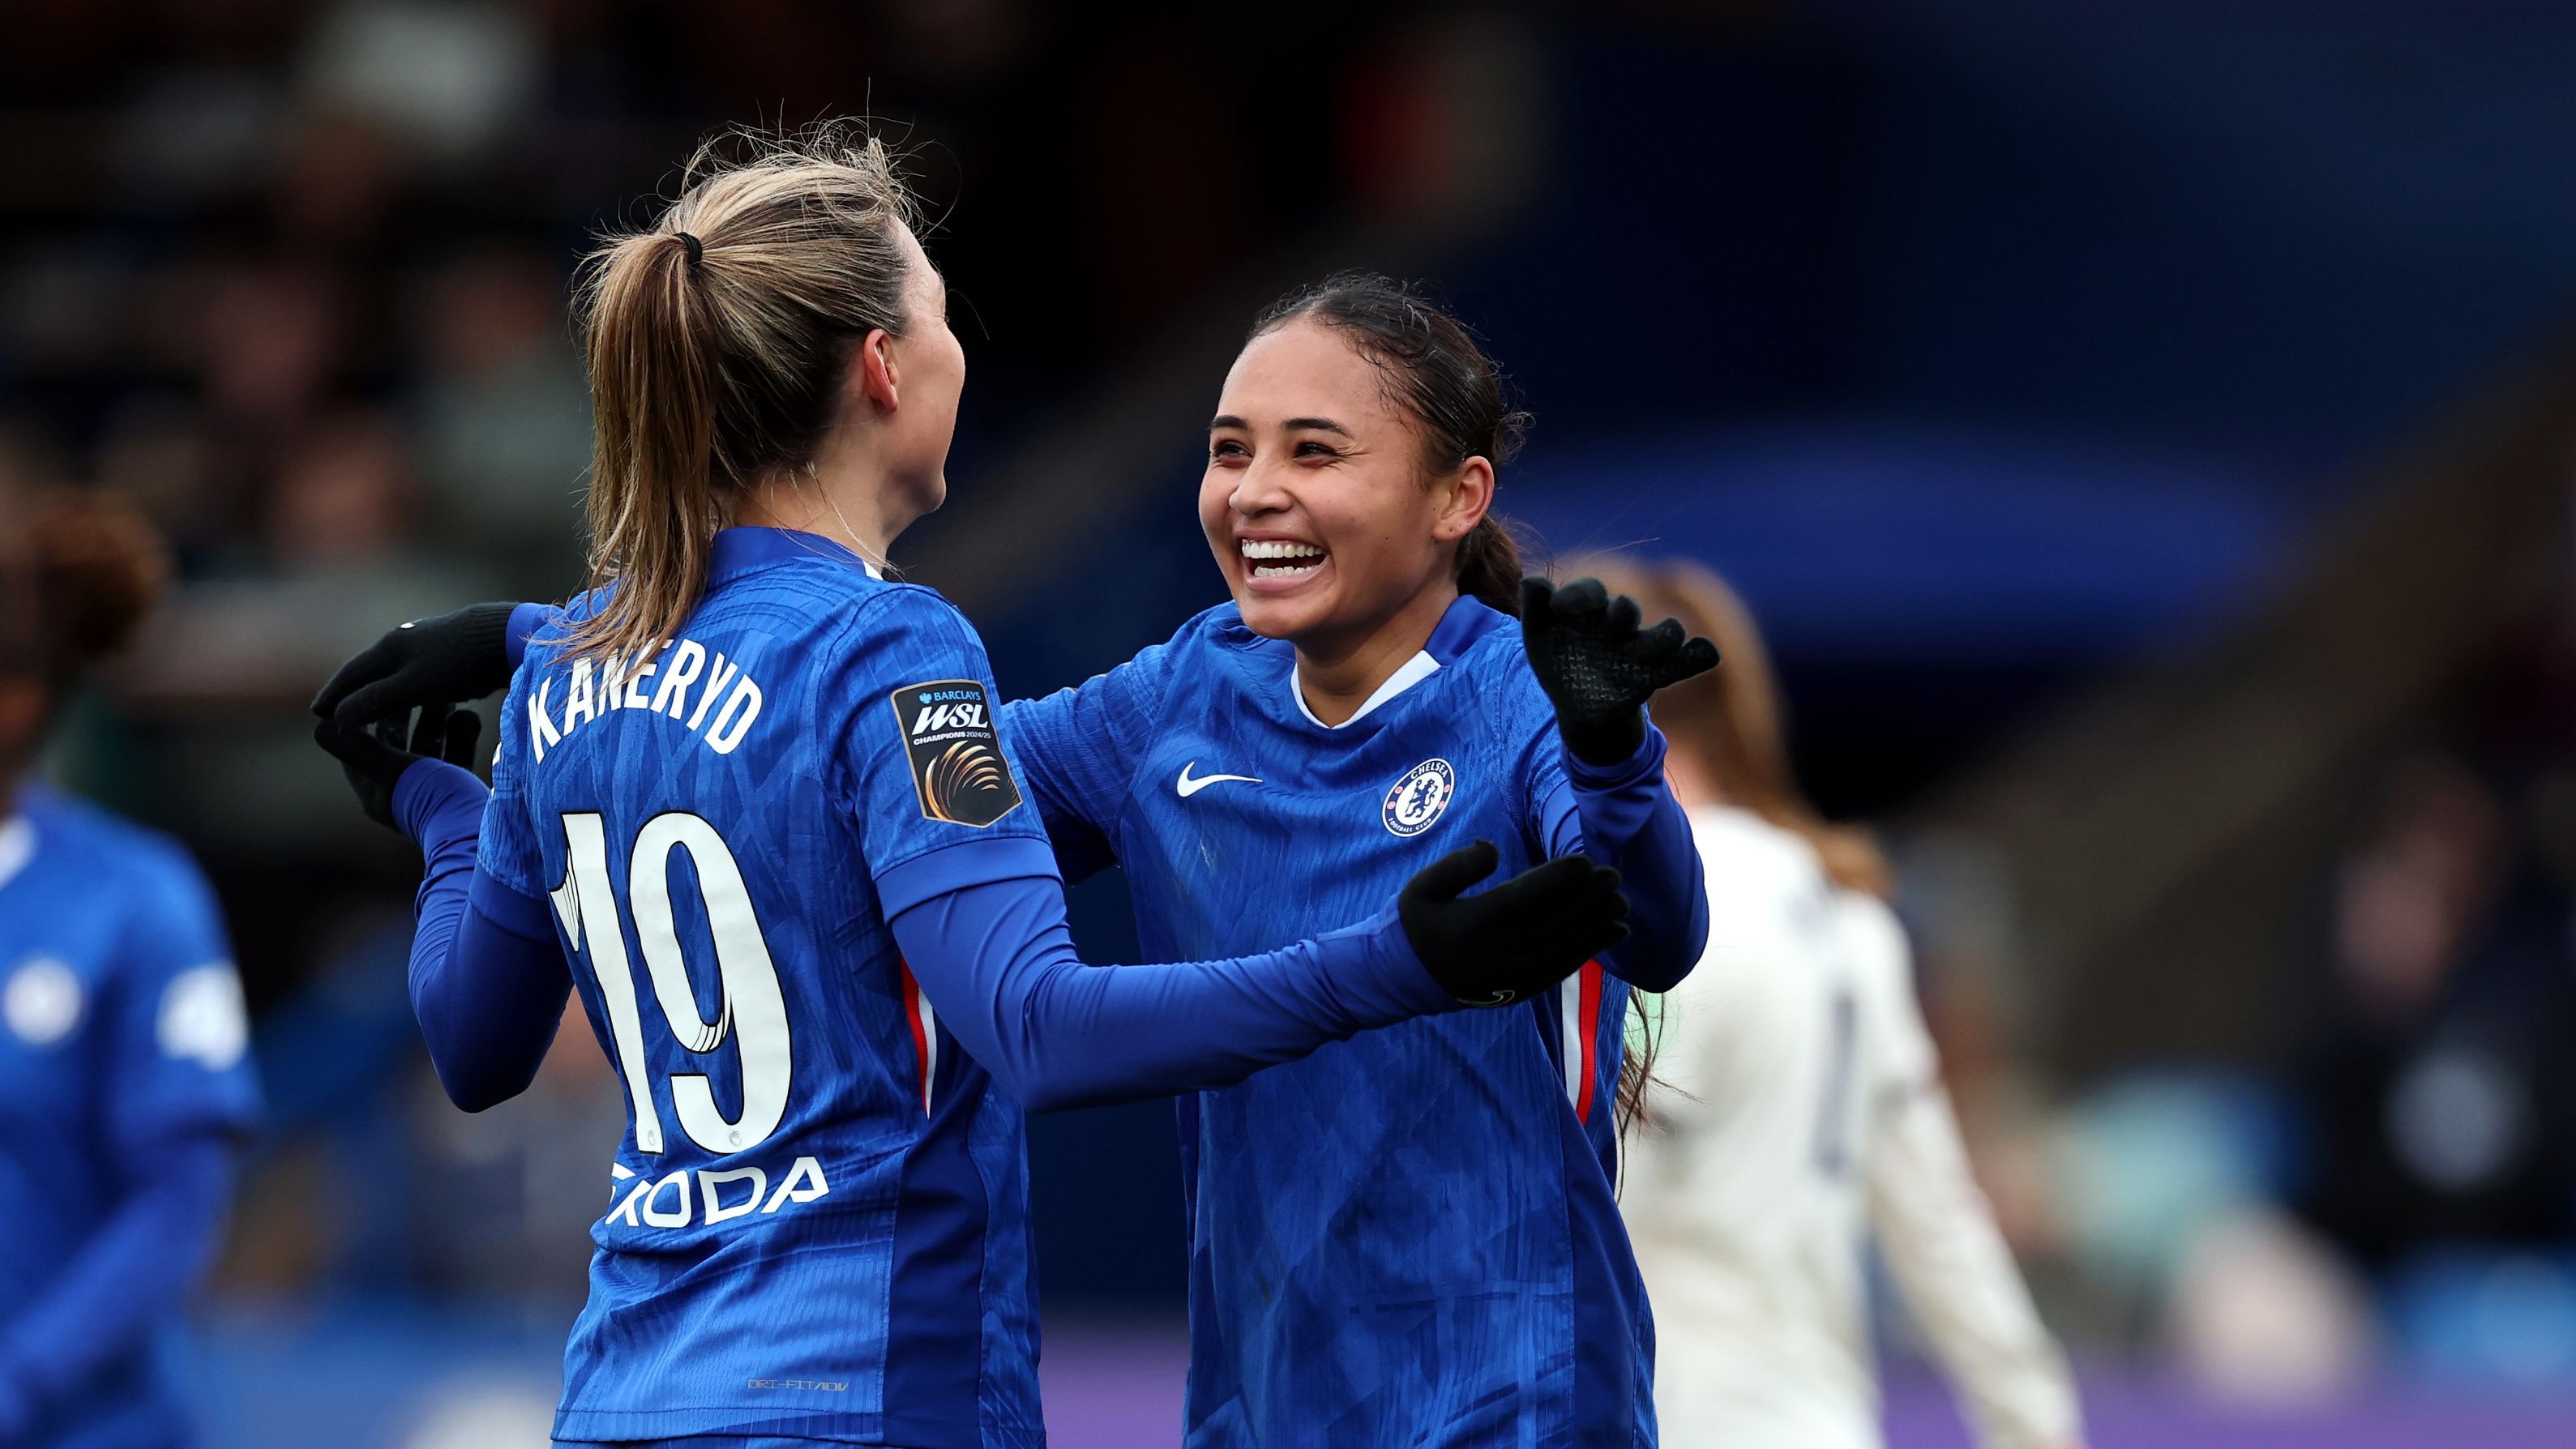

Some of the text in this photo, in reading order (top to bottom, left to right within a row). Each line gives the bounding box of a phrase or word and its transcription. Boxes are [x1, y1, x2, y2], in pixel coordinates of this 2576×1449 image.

[528, 639, 763, 765] KANERYD
[934, 690, 981, 702] BARCLAYS
[911, 703, 988, 736] WSL
[914, 731, 991, 746] CHAMPIONS 2024/25
[1410, 762, 1448, 780] CHELSEA
[1388, 818, 1431, 832] FOOTBALL CLUB
[549, 810, 792, 1156] 19
